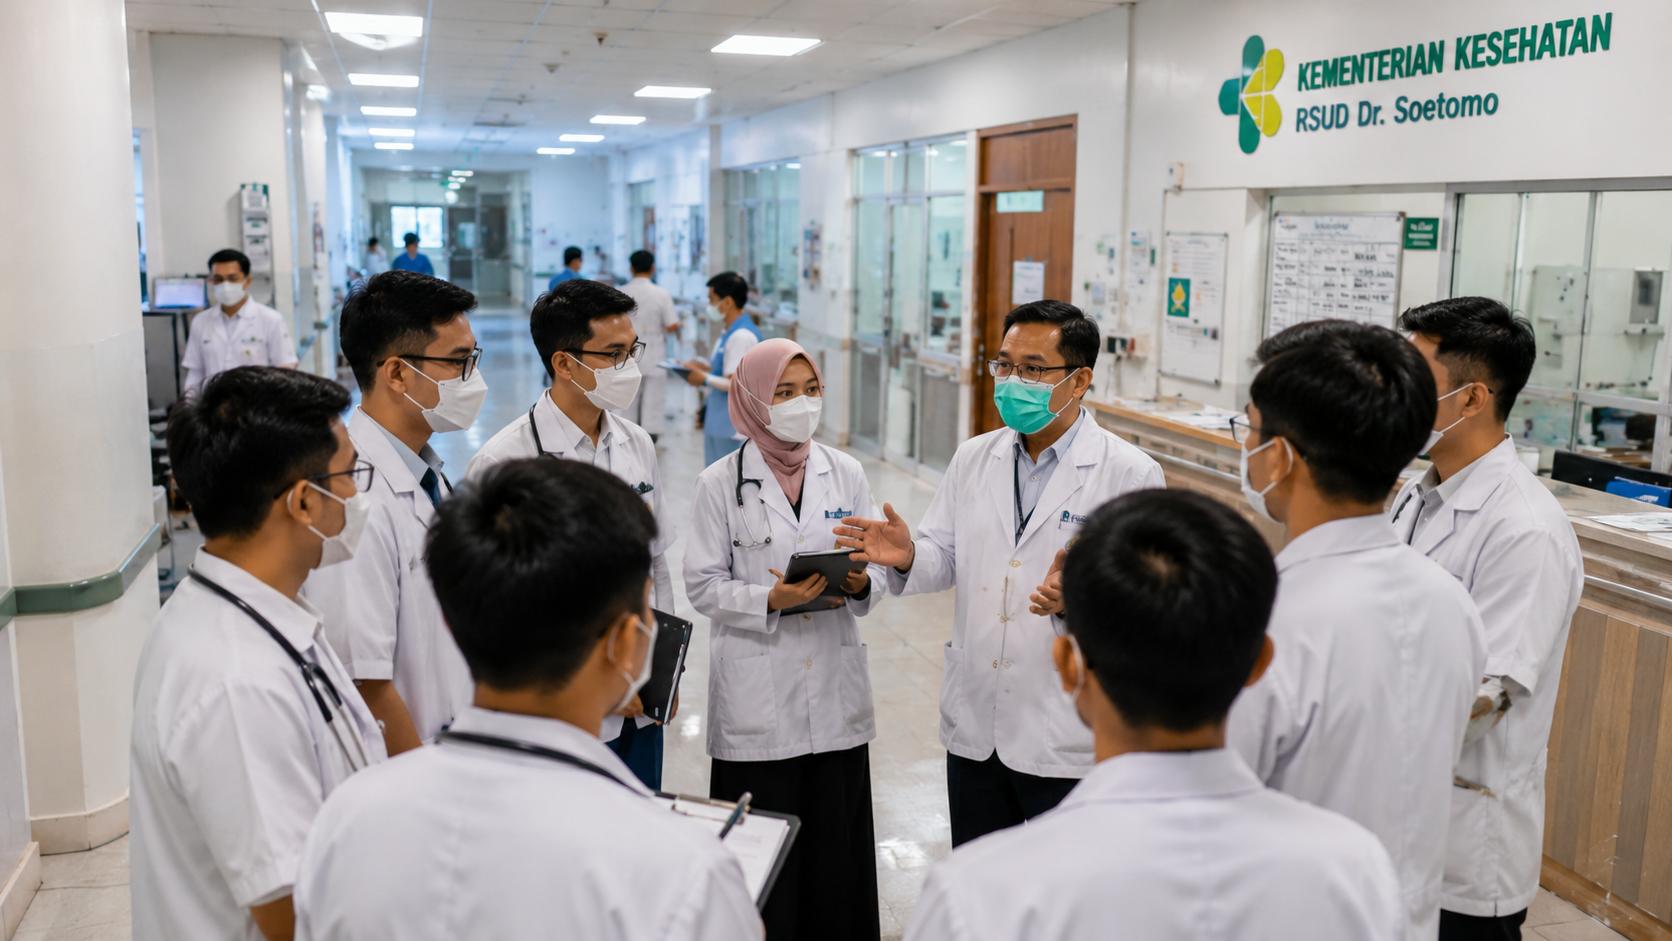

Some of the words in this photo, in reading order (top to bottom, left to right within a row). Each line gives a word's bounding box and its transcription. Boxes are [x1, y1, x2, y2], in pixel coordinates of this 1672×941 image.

[1297, 40, 1445, 92] KEMENTERIAN
[1454, 12, 1613, 71] KESEHATAN
[1296, 103, 1349, 132] RSUD
[1357, 101, 1385, 127] Dr.
[1394, 92, 1499, 124] Soetomo
